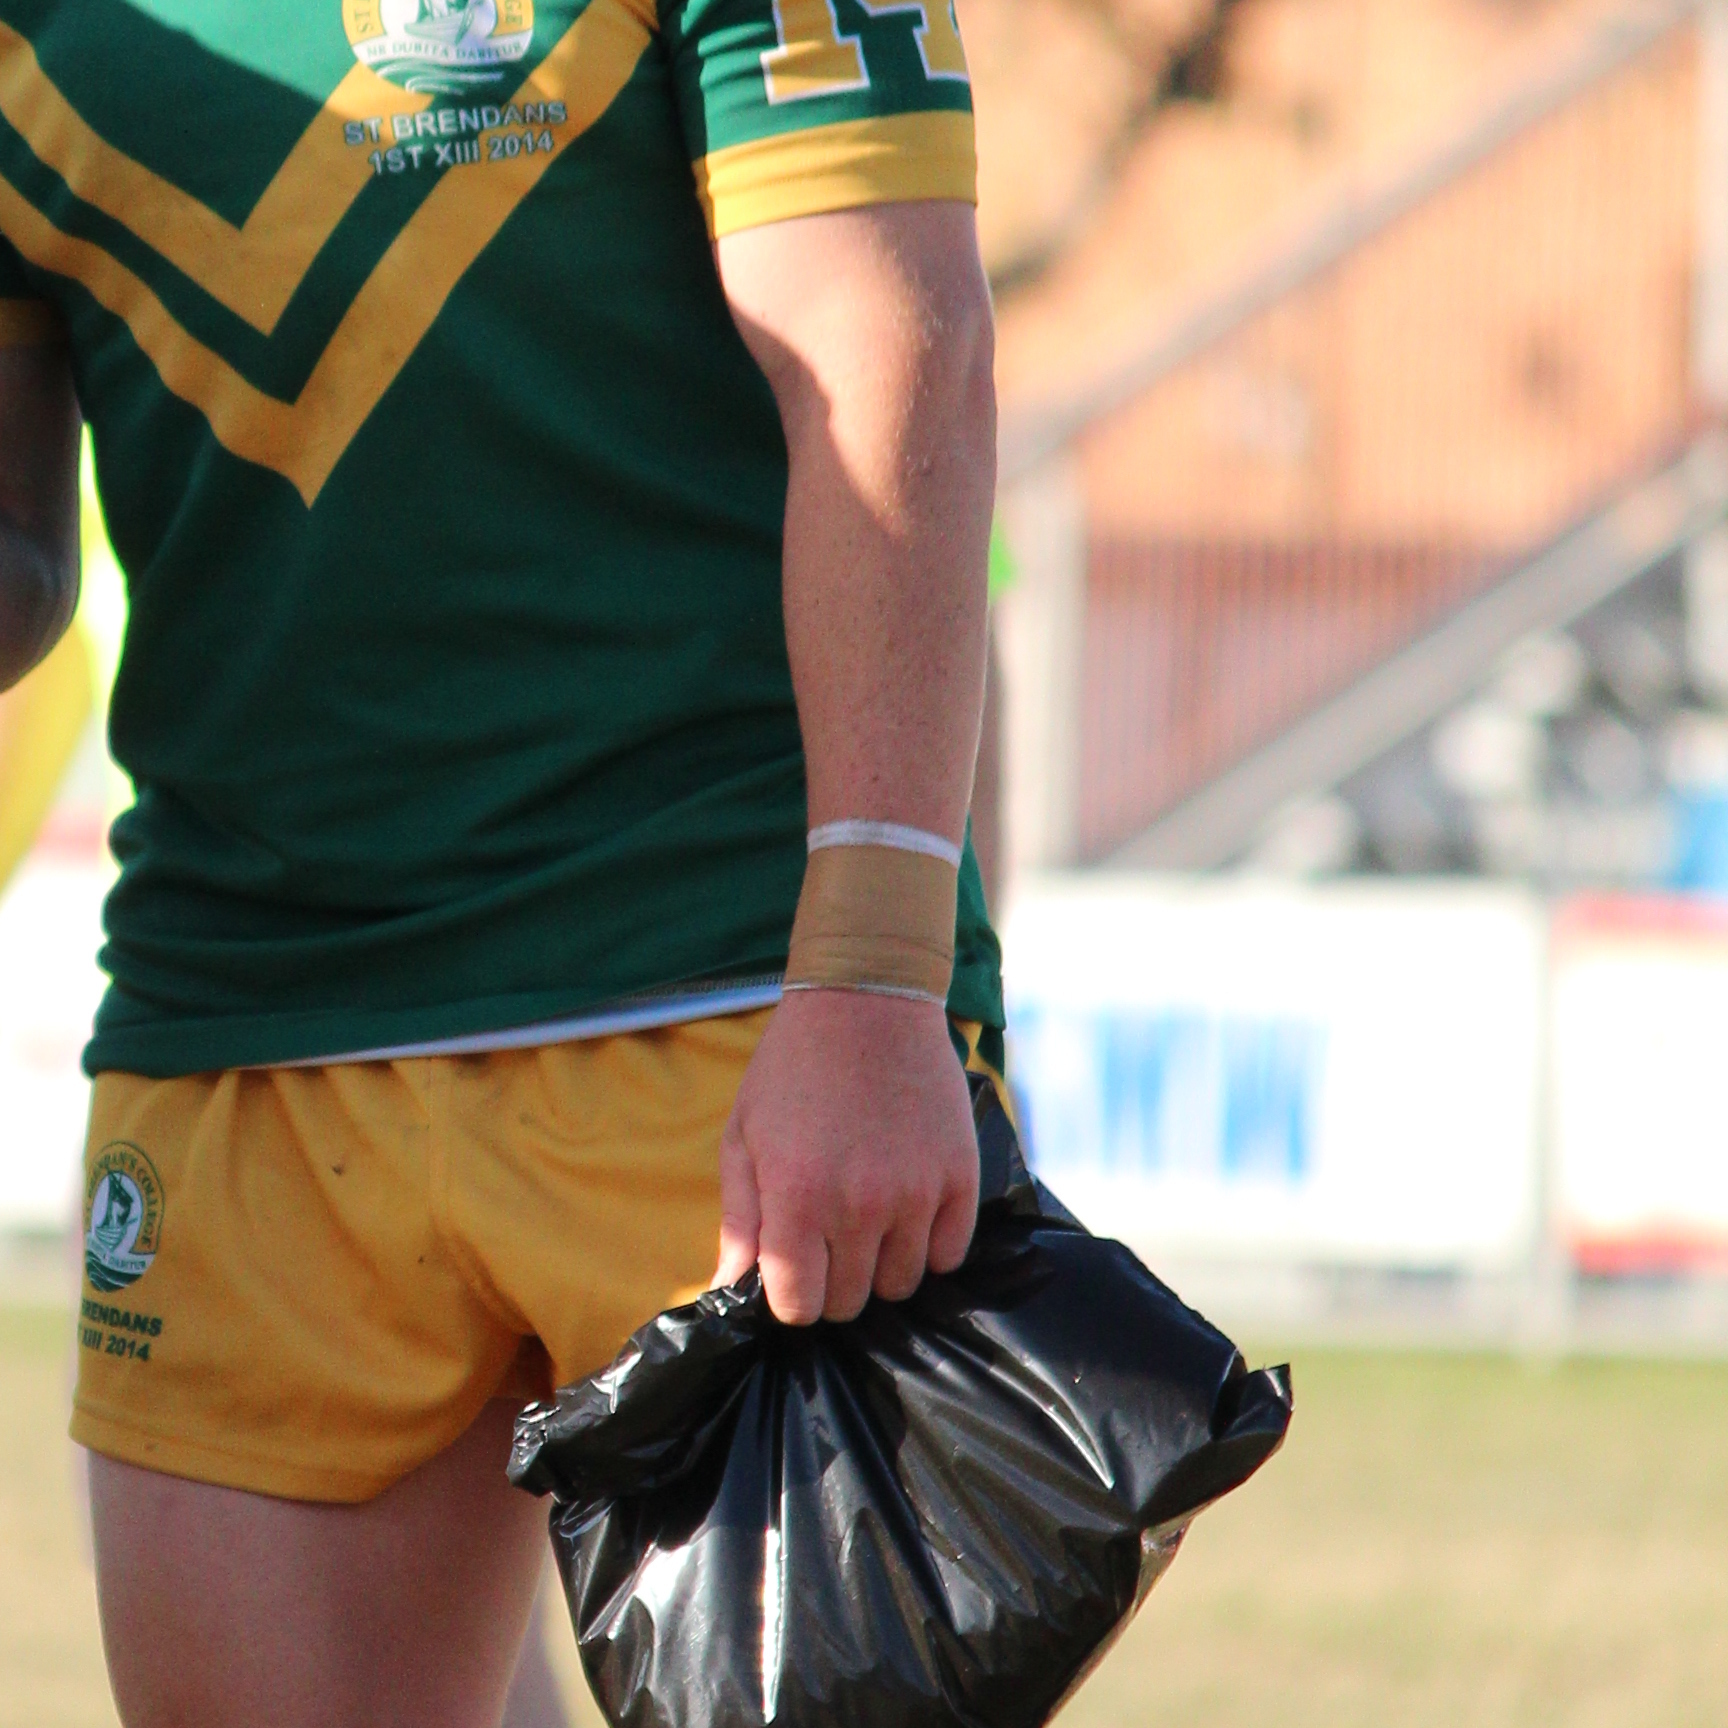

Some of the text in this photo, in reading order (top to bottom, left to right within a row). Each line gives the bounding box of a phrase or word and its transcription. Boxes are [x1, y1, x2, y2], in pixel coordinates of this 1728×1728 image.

[355, 9, 373, 33] ST
[343, 100, 567, 146] ST BRENDANS
[369, 129, 554, 174] 1ST XIII 2014
[105, 1334, 150, 1361] 2014
